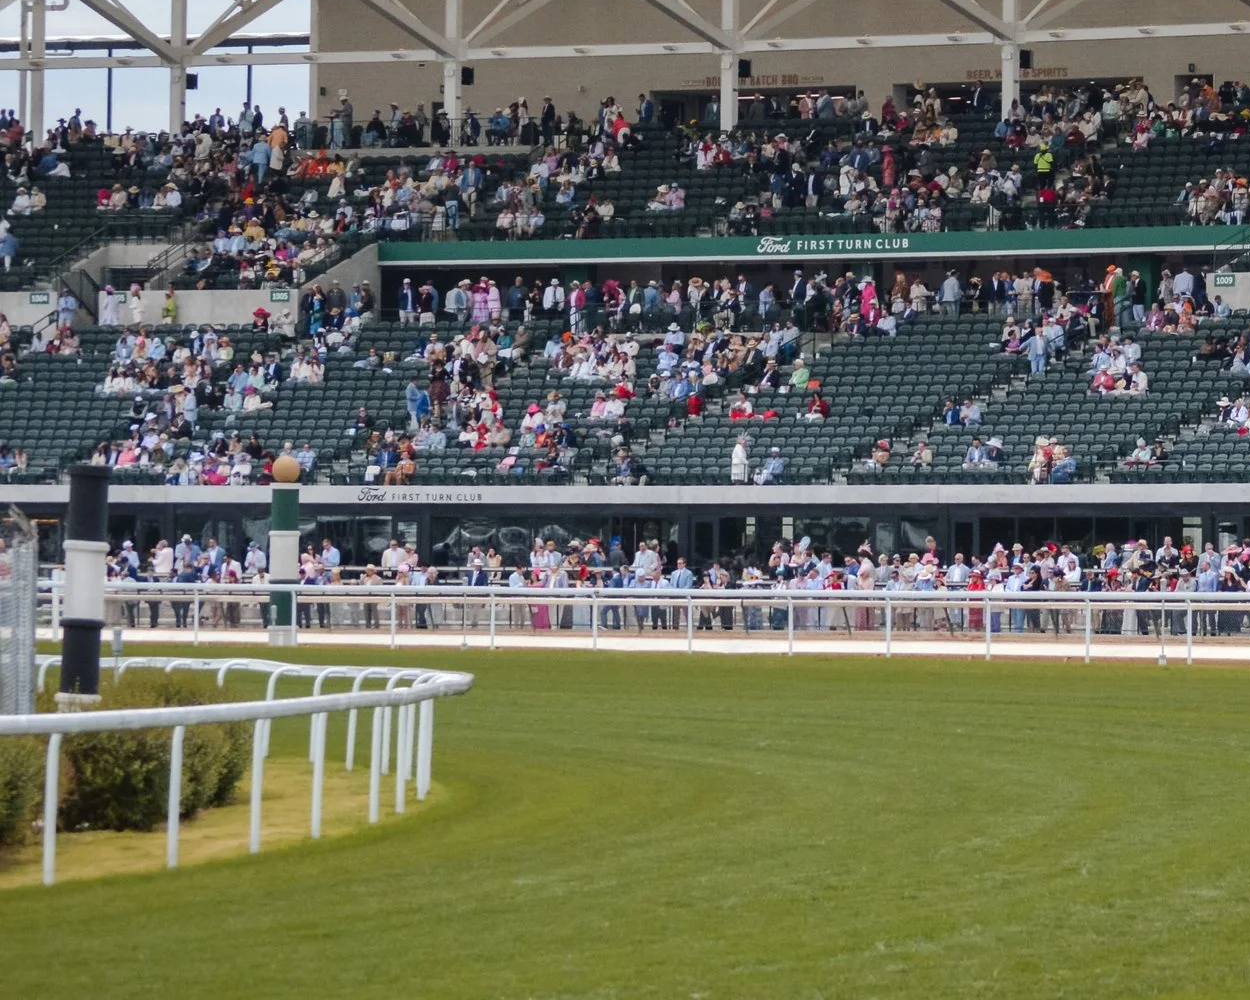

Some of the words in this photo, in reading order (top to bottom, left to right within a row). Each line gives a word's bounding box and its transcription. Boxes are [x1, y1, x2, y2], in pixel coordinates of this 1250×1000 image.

[1032, 67, 1068, 78] SPIRITS
[750, 75, 778, 86] BATCH
[756, 236, 791, 253] Ford
[796, 240, 834, 250] FIRST
[837, 238, 872, 250] TURN
[875, 238, 909, 249] CLUB
[1216, 276, 1233, 284] 1009
[357, 486, 387, 502] Ford
[392, 493, 420, 501] FIRST
[426, 493, 452, 501] TURN
[456, 493, 482, 501] CLUB
